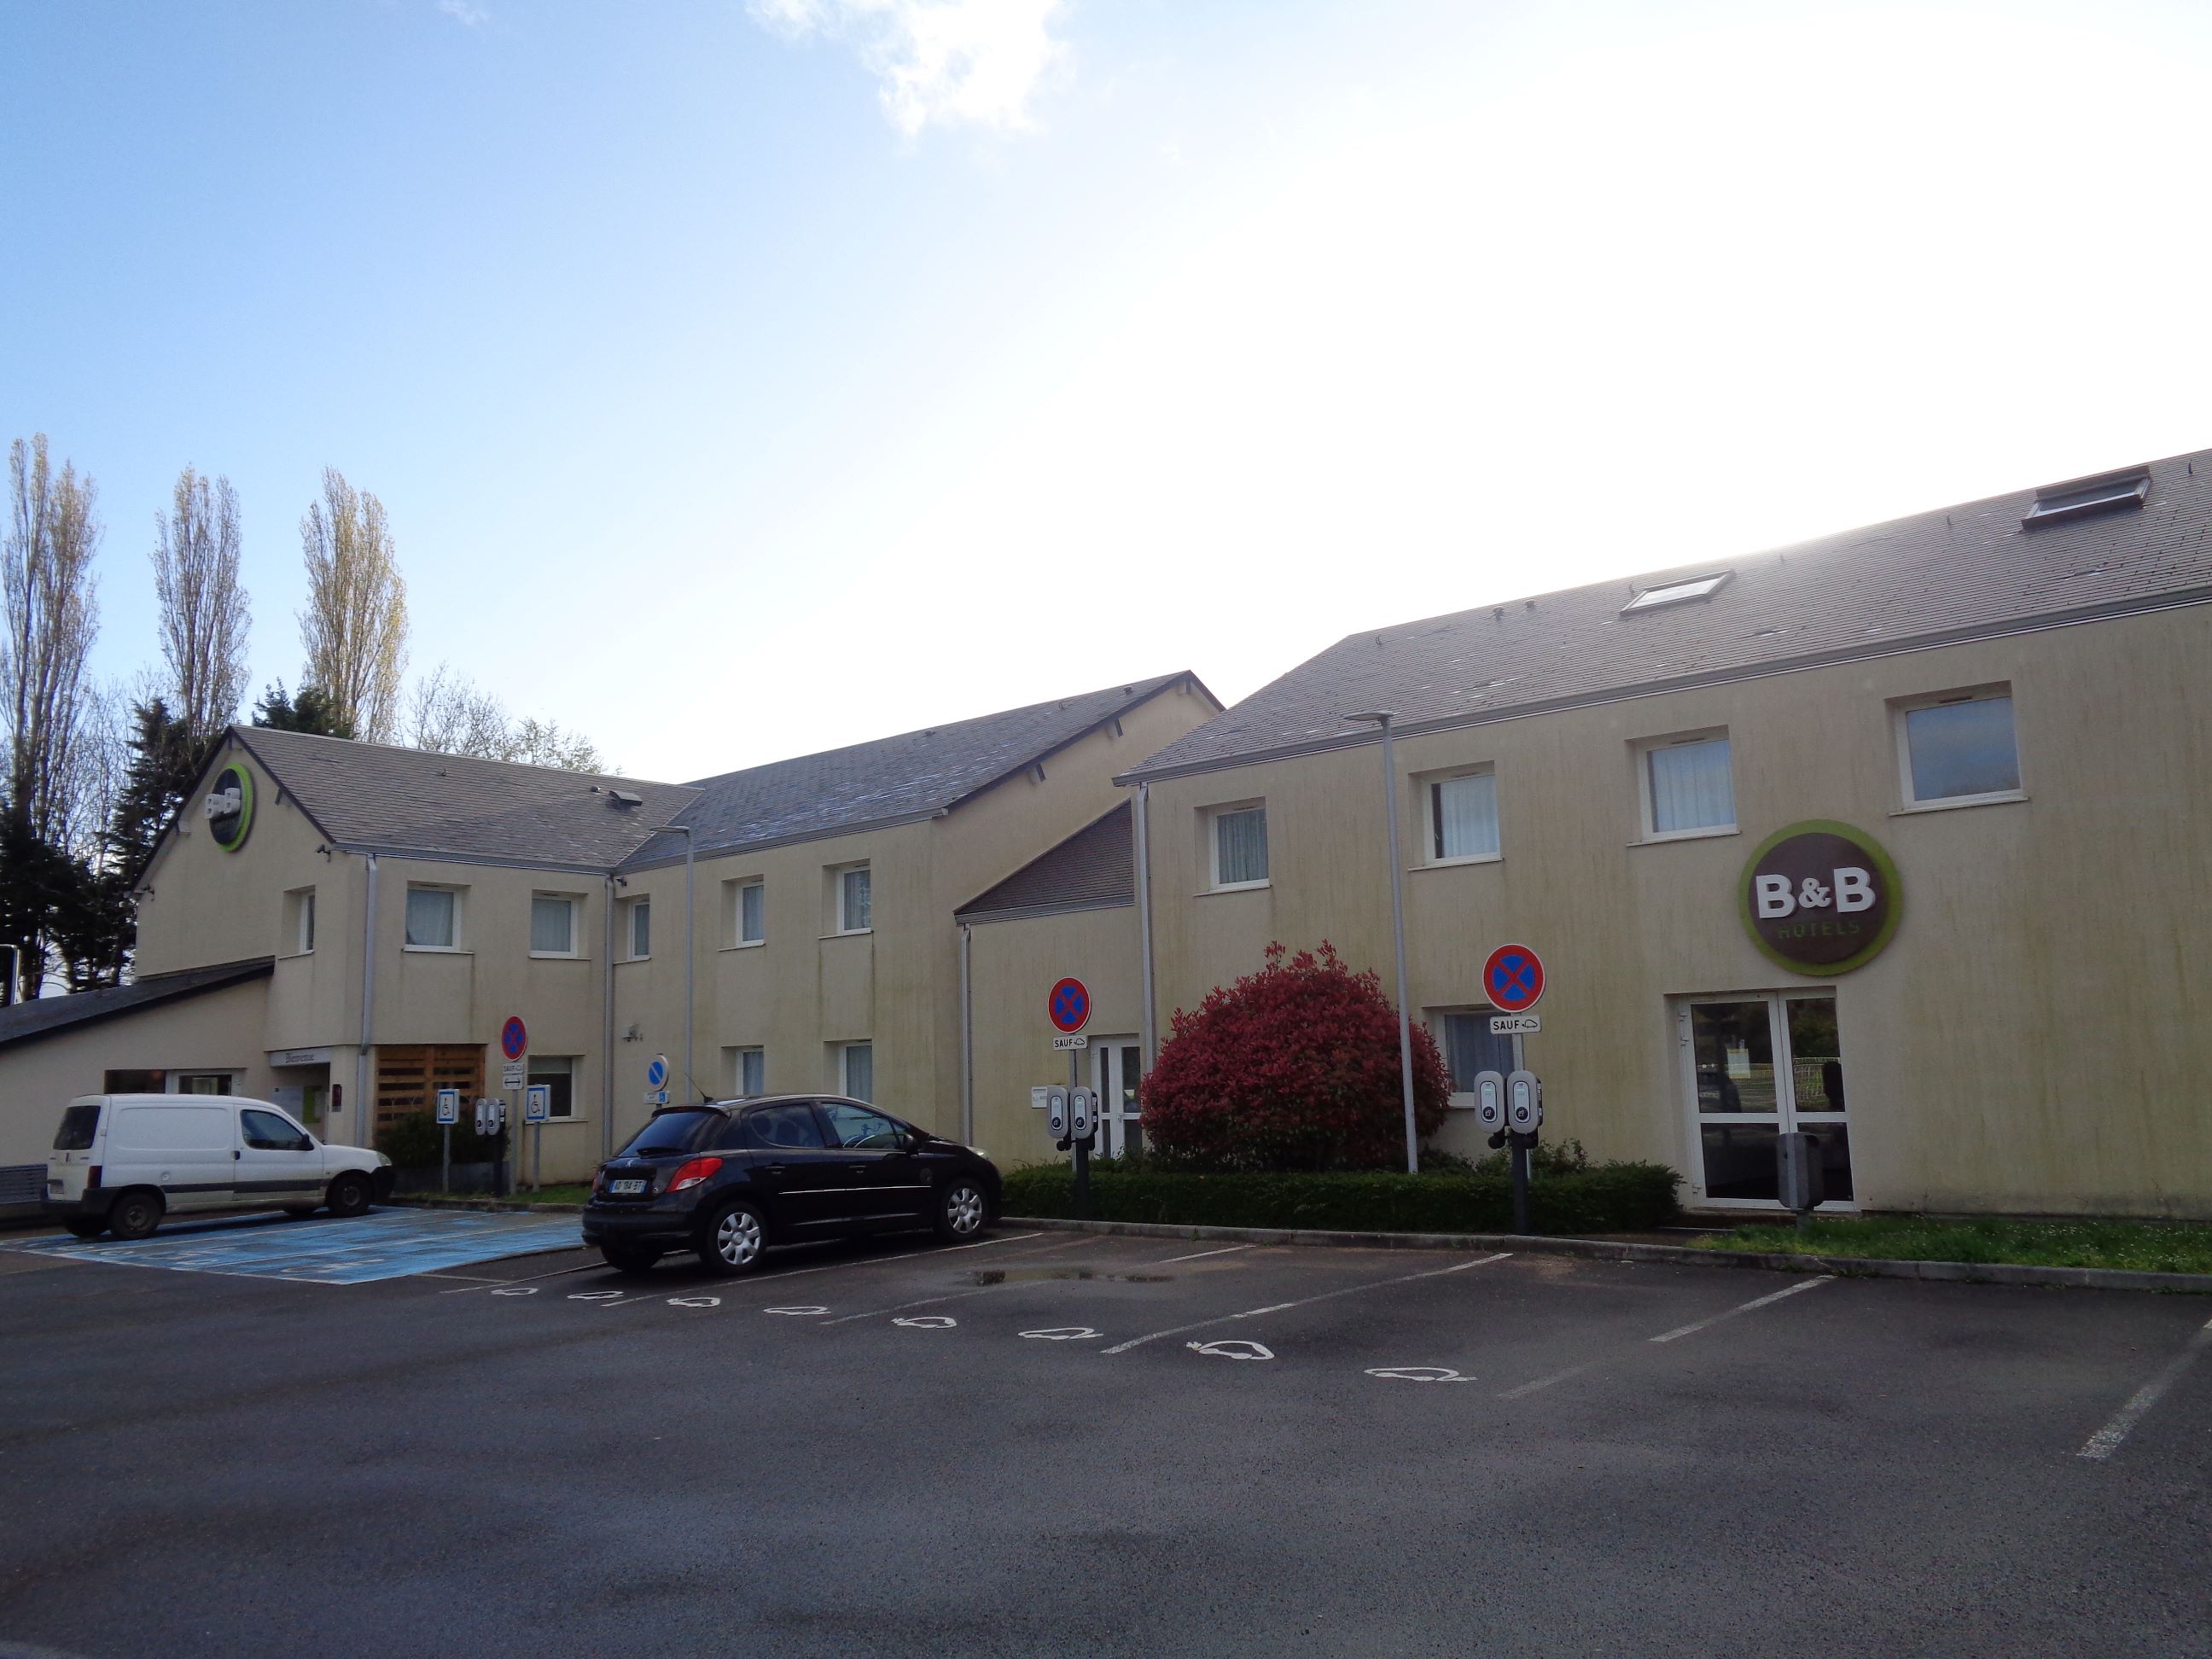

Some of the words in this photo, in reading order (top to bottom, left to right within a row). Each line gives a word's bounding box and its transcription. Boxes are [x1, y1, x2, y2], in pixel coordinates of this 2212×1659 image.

[205, 787, 240, 819] BB
[1755, 866, 1876, 919] B&B
[1778, 920, 1861, 940] HOTELS
[1493, 1020, 1519, 1030] SAUF
[1054, 1039, 1073, 1048] SAUF
